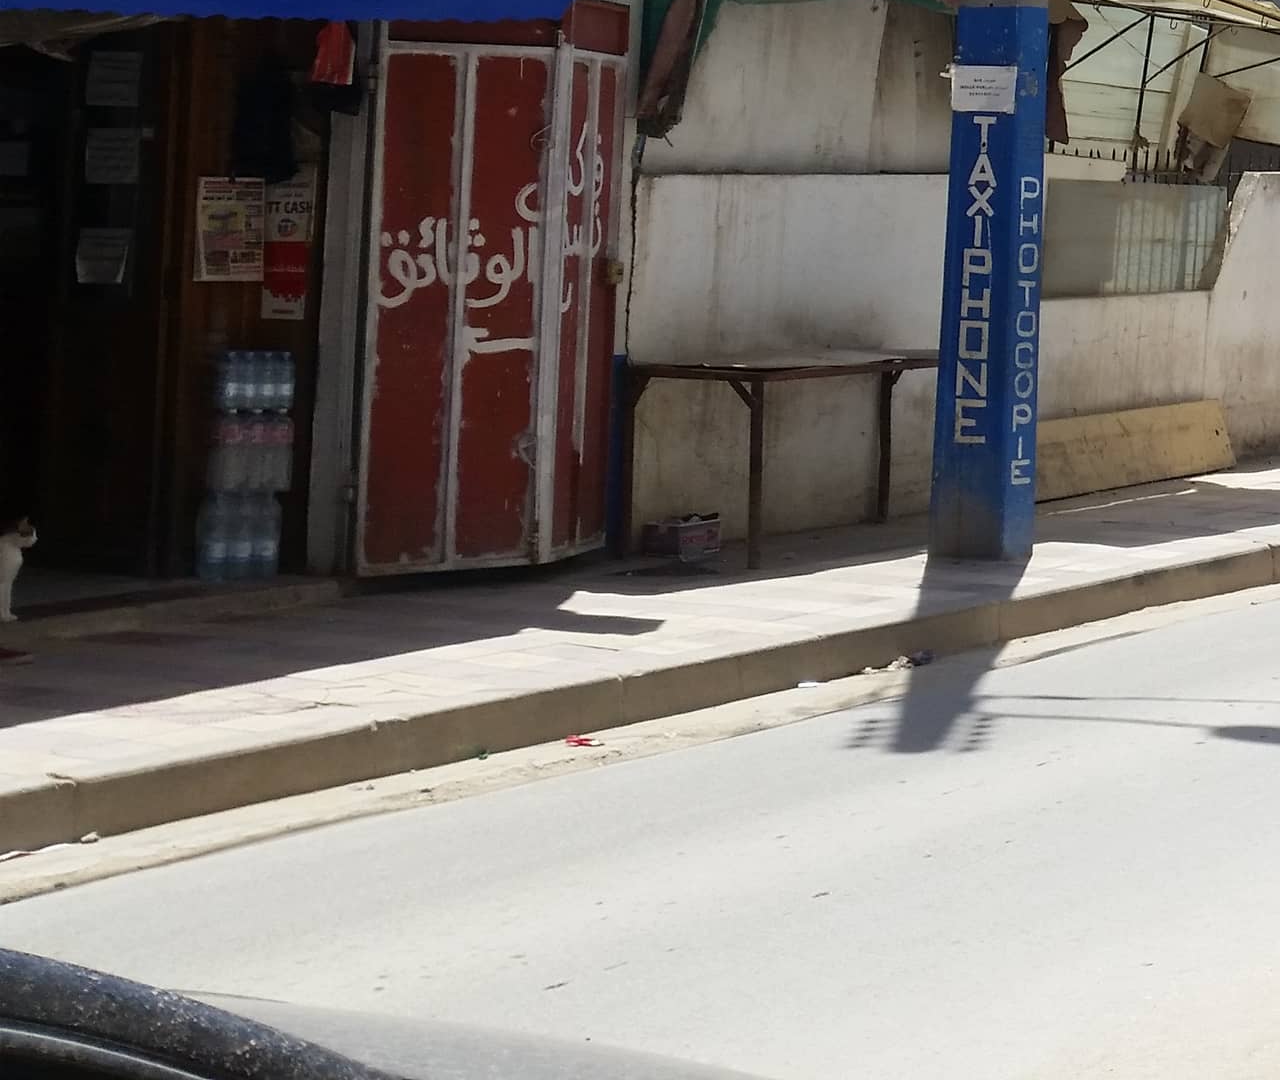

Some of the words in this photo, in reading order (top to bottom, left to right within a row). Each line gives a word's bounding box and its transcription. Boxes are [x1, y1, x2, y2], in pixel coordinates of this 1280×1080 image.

[284, 201, 312, 215] CASH
[954, 116, 997, 444] TAXIPHONE
[1010, 176, 1041, 486] PHOTOCOPIE
